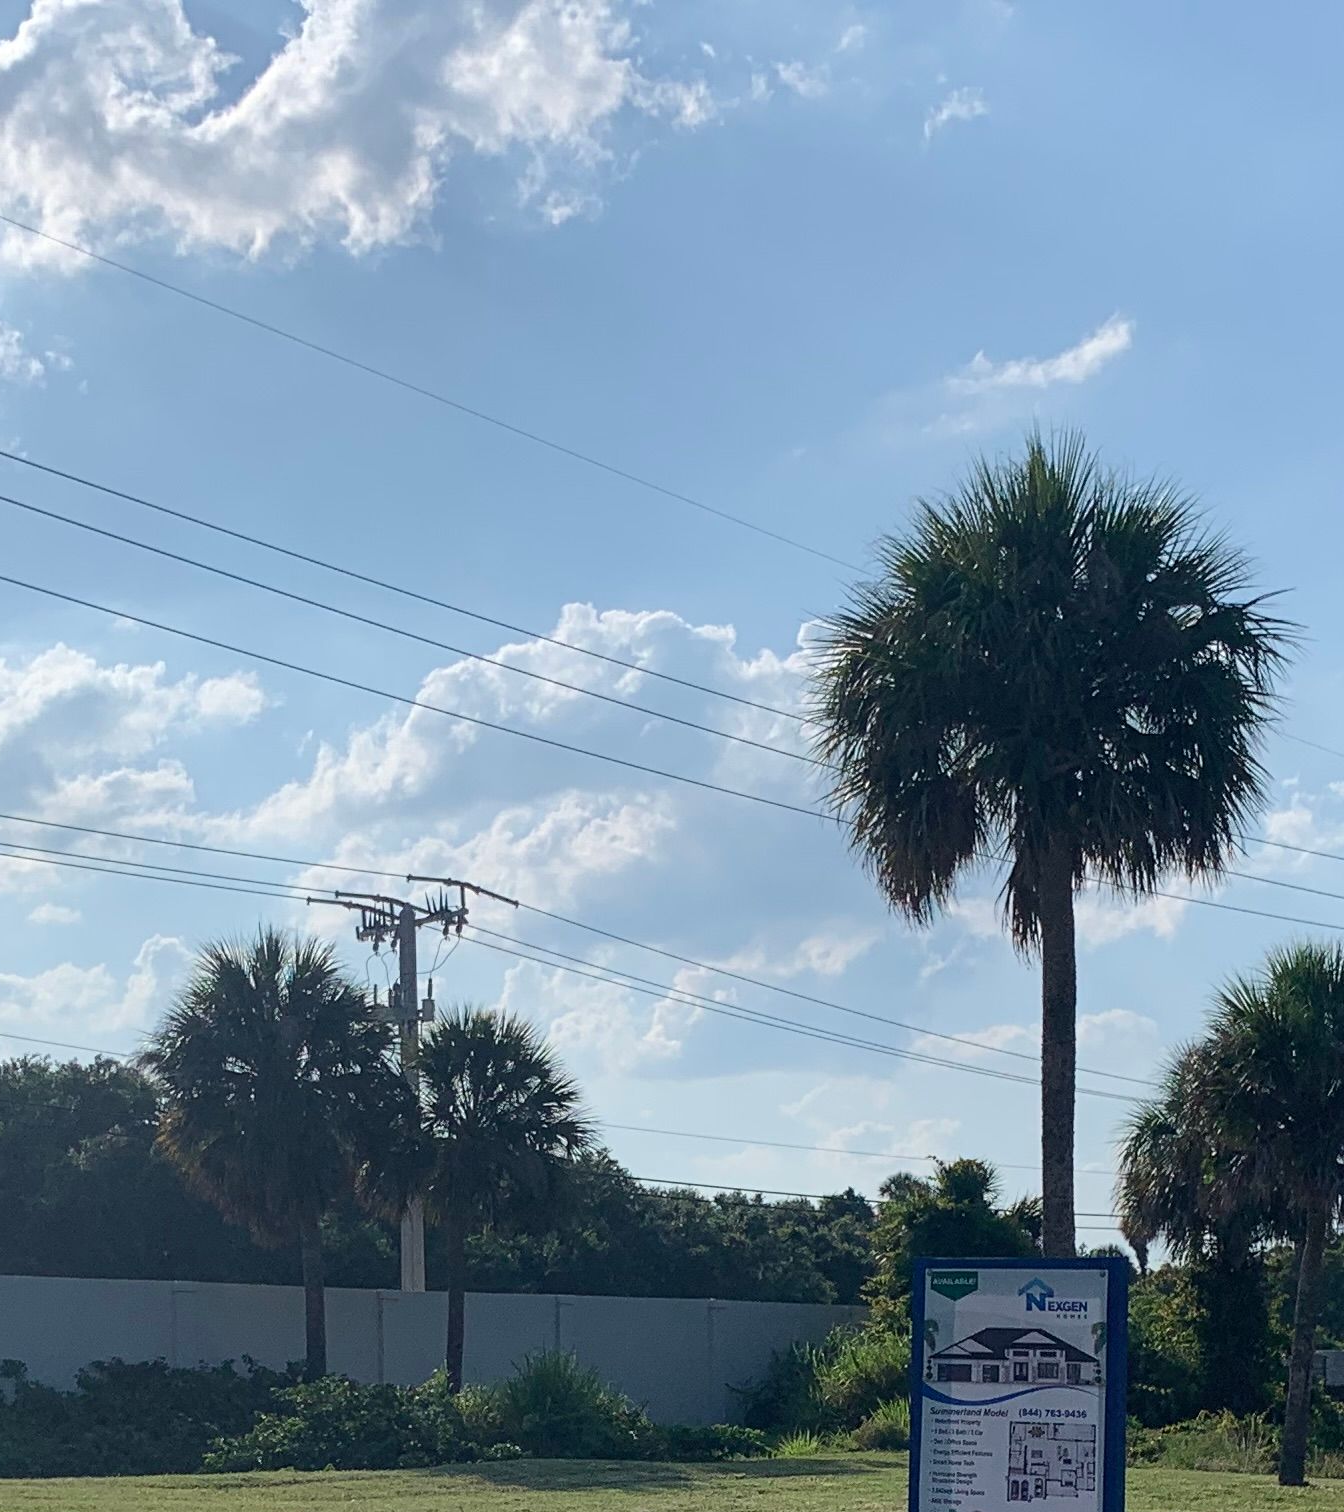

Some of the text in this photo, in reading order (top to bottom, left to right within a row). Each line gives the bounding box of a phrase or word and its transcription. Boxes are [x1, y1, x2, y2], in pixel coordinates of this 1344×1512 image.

[1026, 1293, 1088, 1311] NEXGEN
[929, 1407, 1008, 1417] Summerland Model
[1019, 1408, 1042, 1418] (844)
